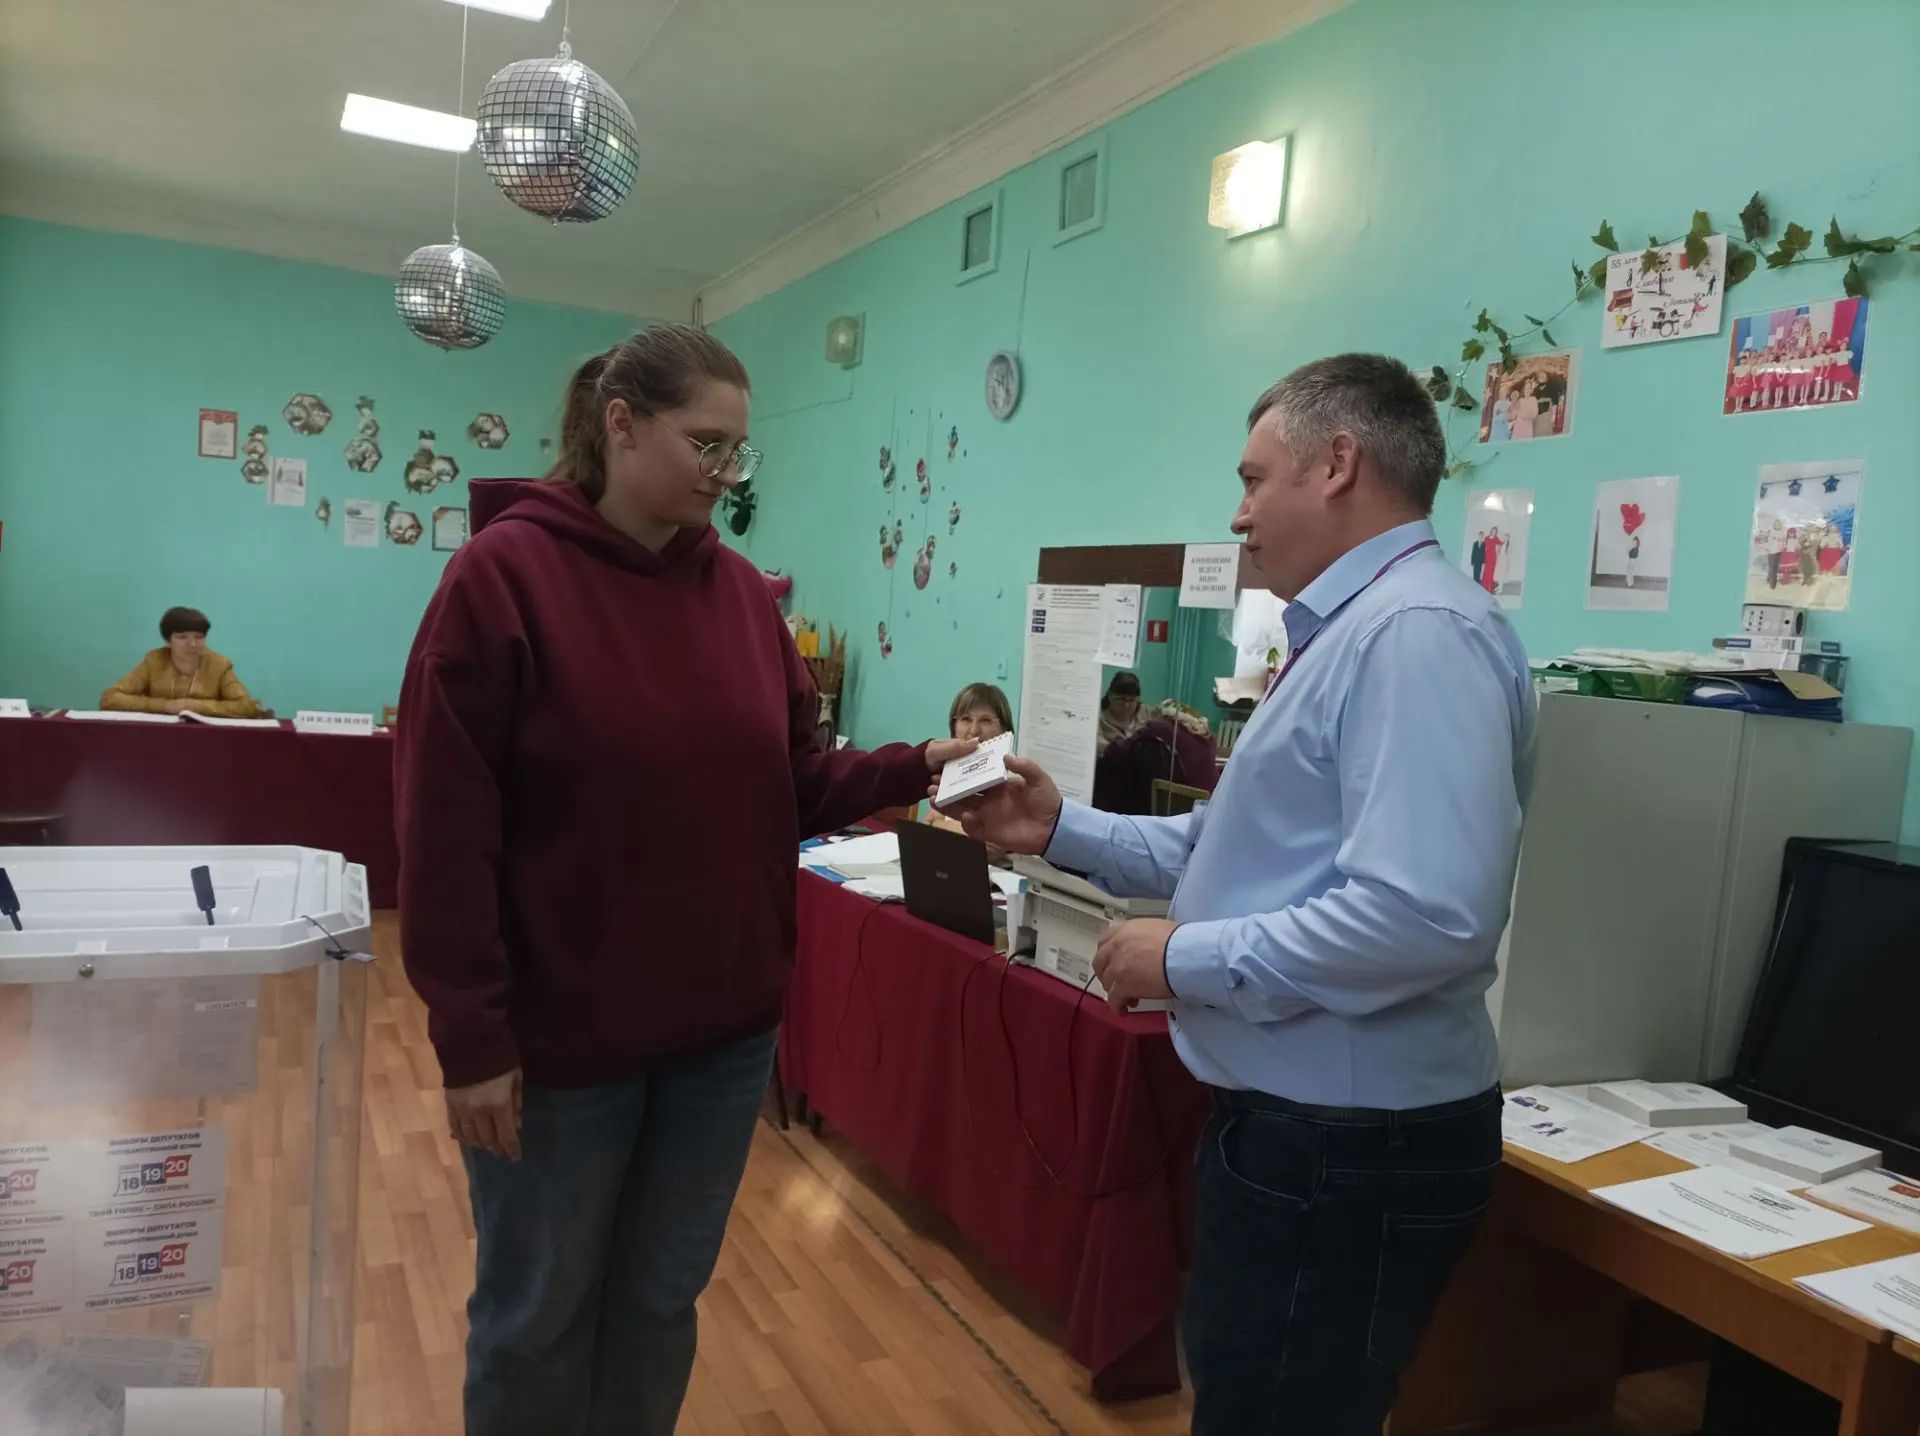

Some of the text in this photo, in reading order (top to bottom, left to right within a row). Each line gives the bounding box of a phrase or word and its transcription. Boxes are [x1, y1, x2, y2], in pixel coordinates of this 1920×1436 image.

[1611, 258, 1621, 269] 55
[150, 1132, 201, 1143] ДЕПУТАТОВ
[11, 1174, 34, 1188] 20
[122, 1160, 186, 1191] 18 19 20
[147, 1221, 197, 1233] ДЕПУТАТОВ
[118, 1249, 183, 1280] 18 19 20
[7, 1266, 31, 1280] 20
